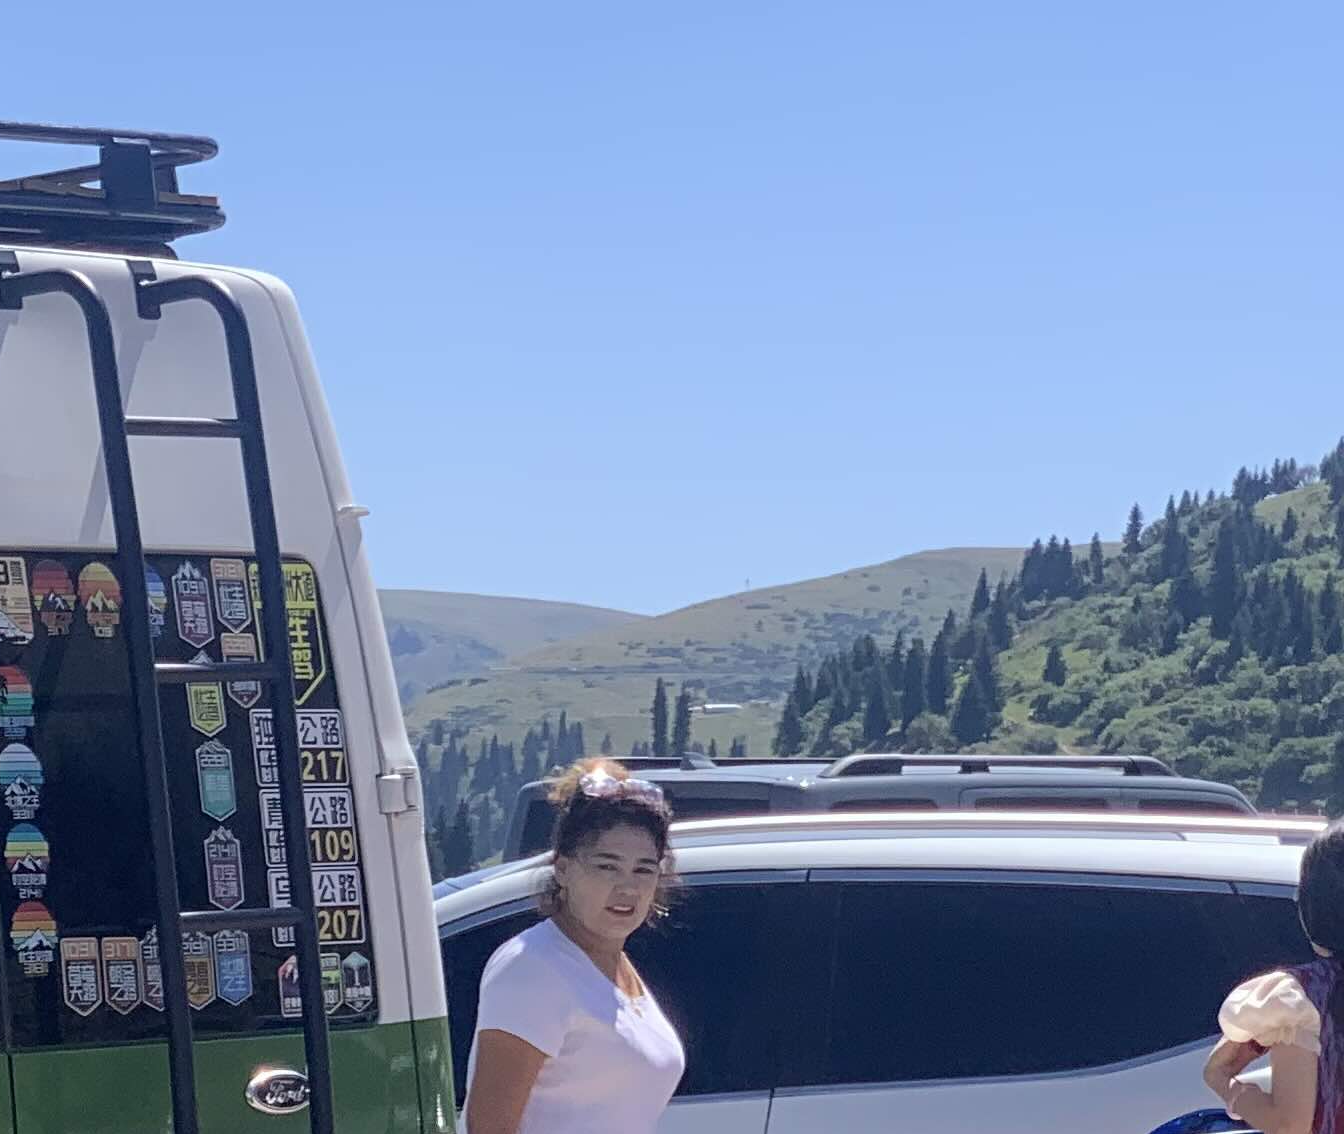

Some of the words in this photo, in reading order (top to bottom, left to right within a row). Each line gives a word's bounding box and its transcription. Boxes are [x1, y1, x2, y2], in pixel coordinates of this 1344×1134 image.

[299, 716, 340, 746] 公路
[301, 751, 344, 781] 217
[309, 796, 349, 825] 公路
[311, 830, 354, 862] 109
[317, 874, 357, 904] 公路
[318, 909, 360, 940] 207
[265, 1080, 305, 1104] Ford
